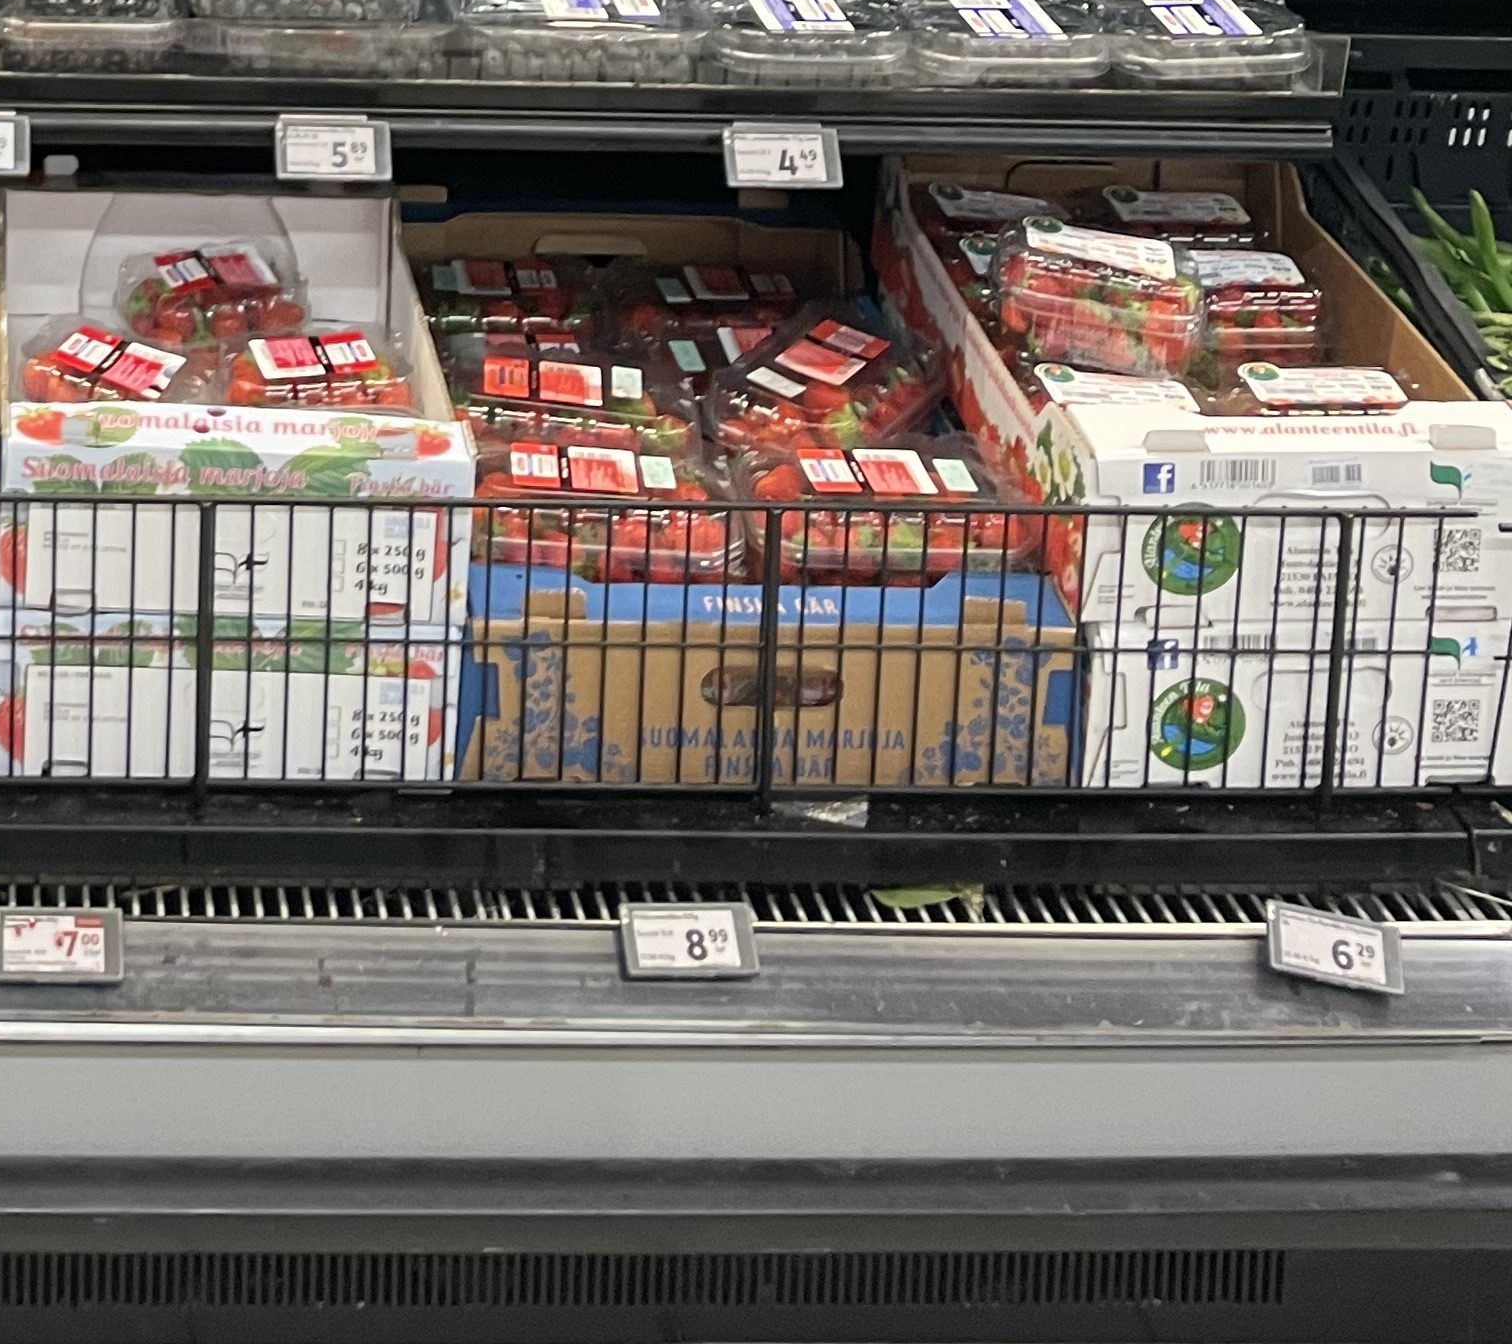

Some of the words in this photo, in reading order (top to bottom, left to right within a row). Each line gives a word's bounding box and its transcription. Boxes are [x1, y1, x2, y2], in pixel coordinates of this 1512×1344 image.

[1203, 422, 1418, 438] www.alanteentila.fi
[21, 455, 190, 487] Suomalaisia
[199, 464, 308, 492] marjoja
